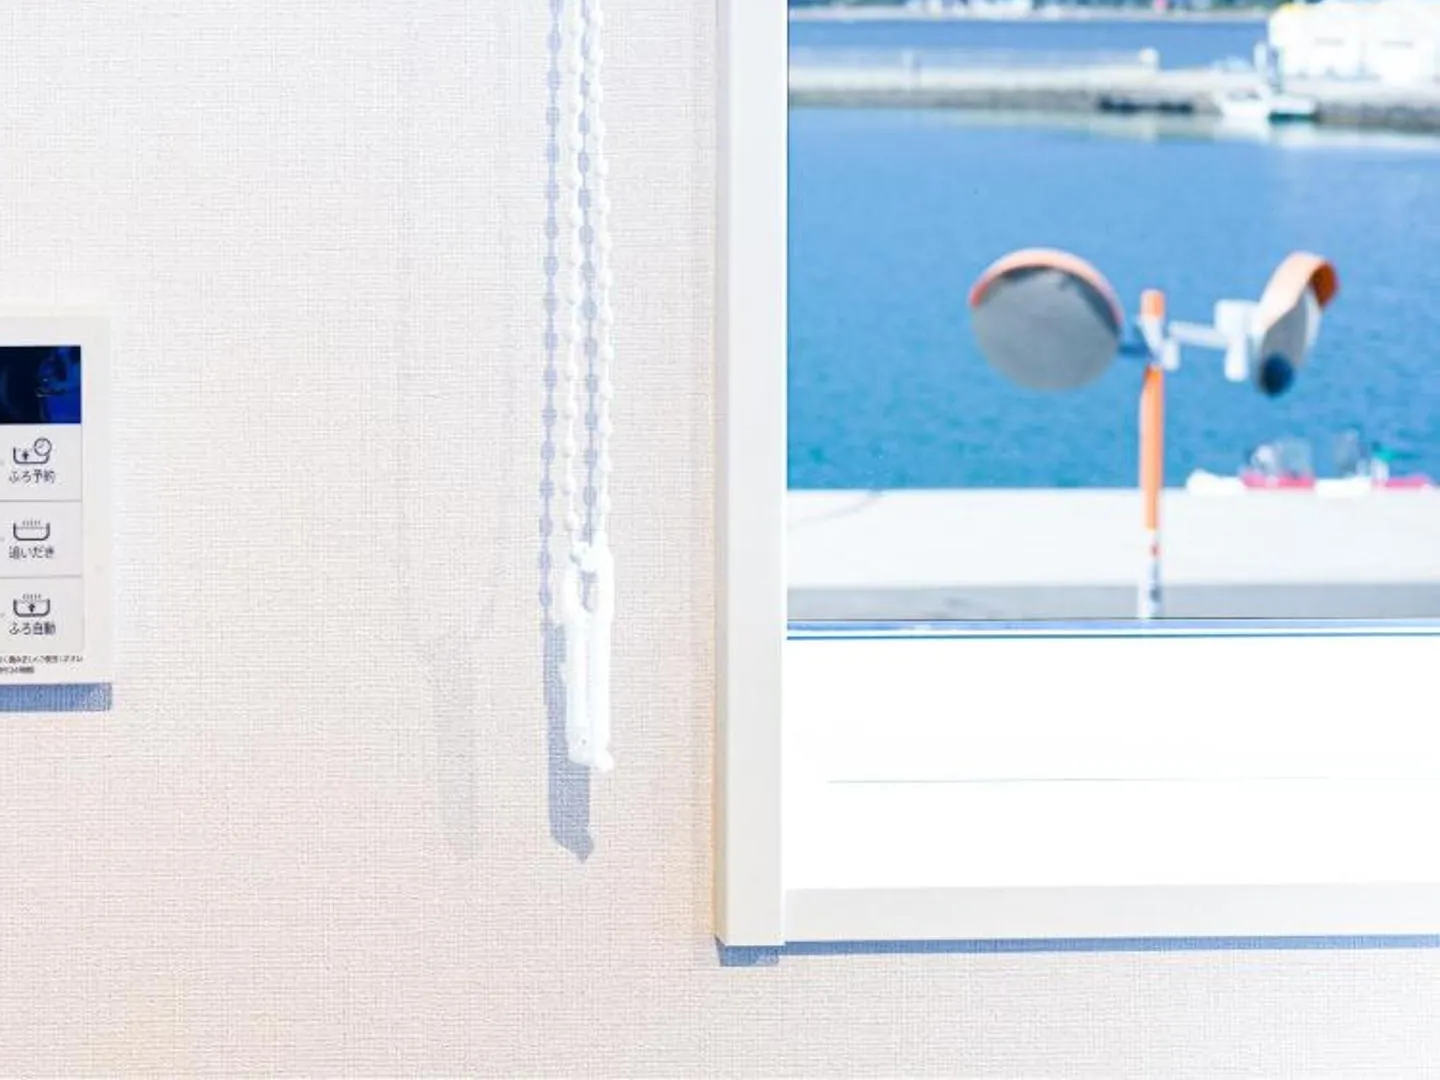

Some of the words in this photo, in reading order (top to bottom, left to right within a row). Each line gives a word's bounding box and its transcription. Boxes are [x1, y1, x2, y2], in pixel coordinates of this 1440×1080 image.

[9, 469, 57, 484] ふろ予約
[9, 545, 55, 560] 追いだき
[9, 622, 57, 637] ふろ自動
